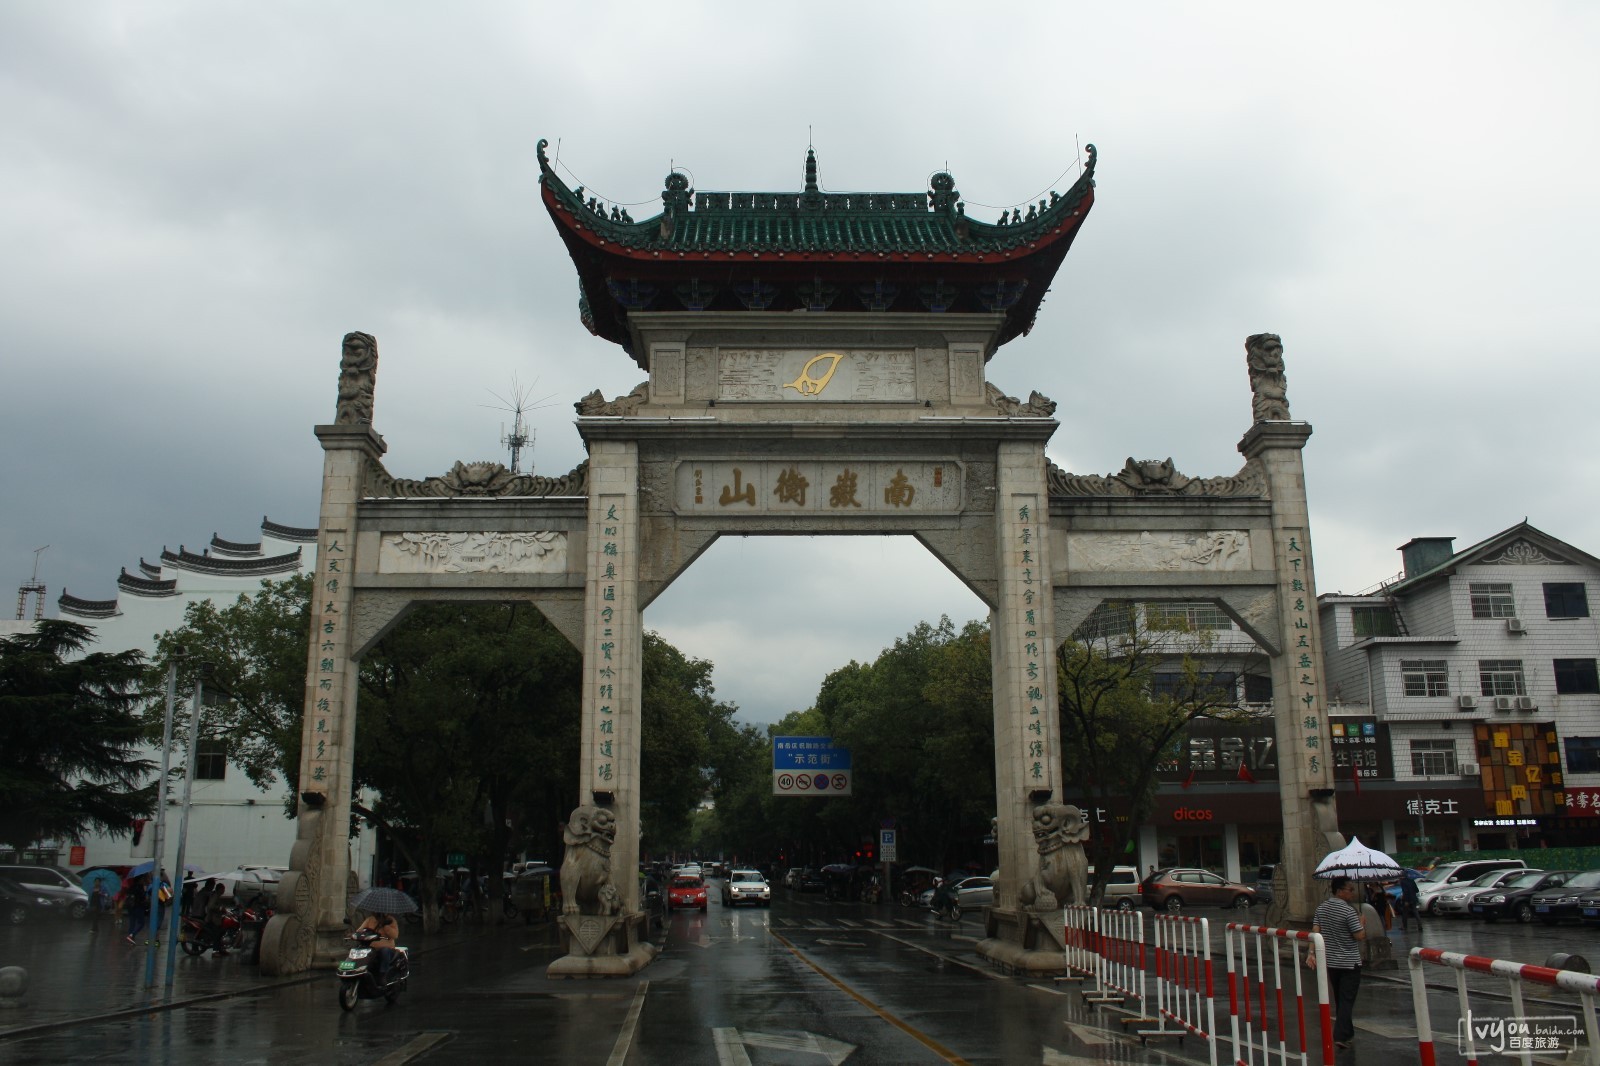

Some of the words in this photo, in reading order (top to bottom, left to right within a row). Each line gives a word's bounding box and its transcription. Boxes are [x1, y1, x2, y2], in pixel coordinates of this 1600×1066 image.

[1331, 748, 1377, 767] 生活馆
[1173, 807, 1213, 821] dicos
[1406, 799, 1458, 815] 德克士
